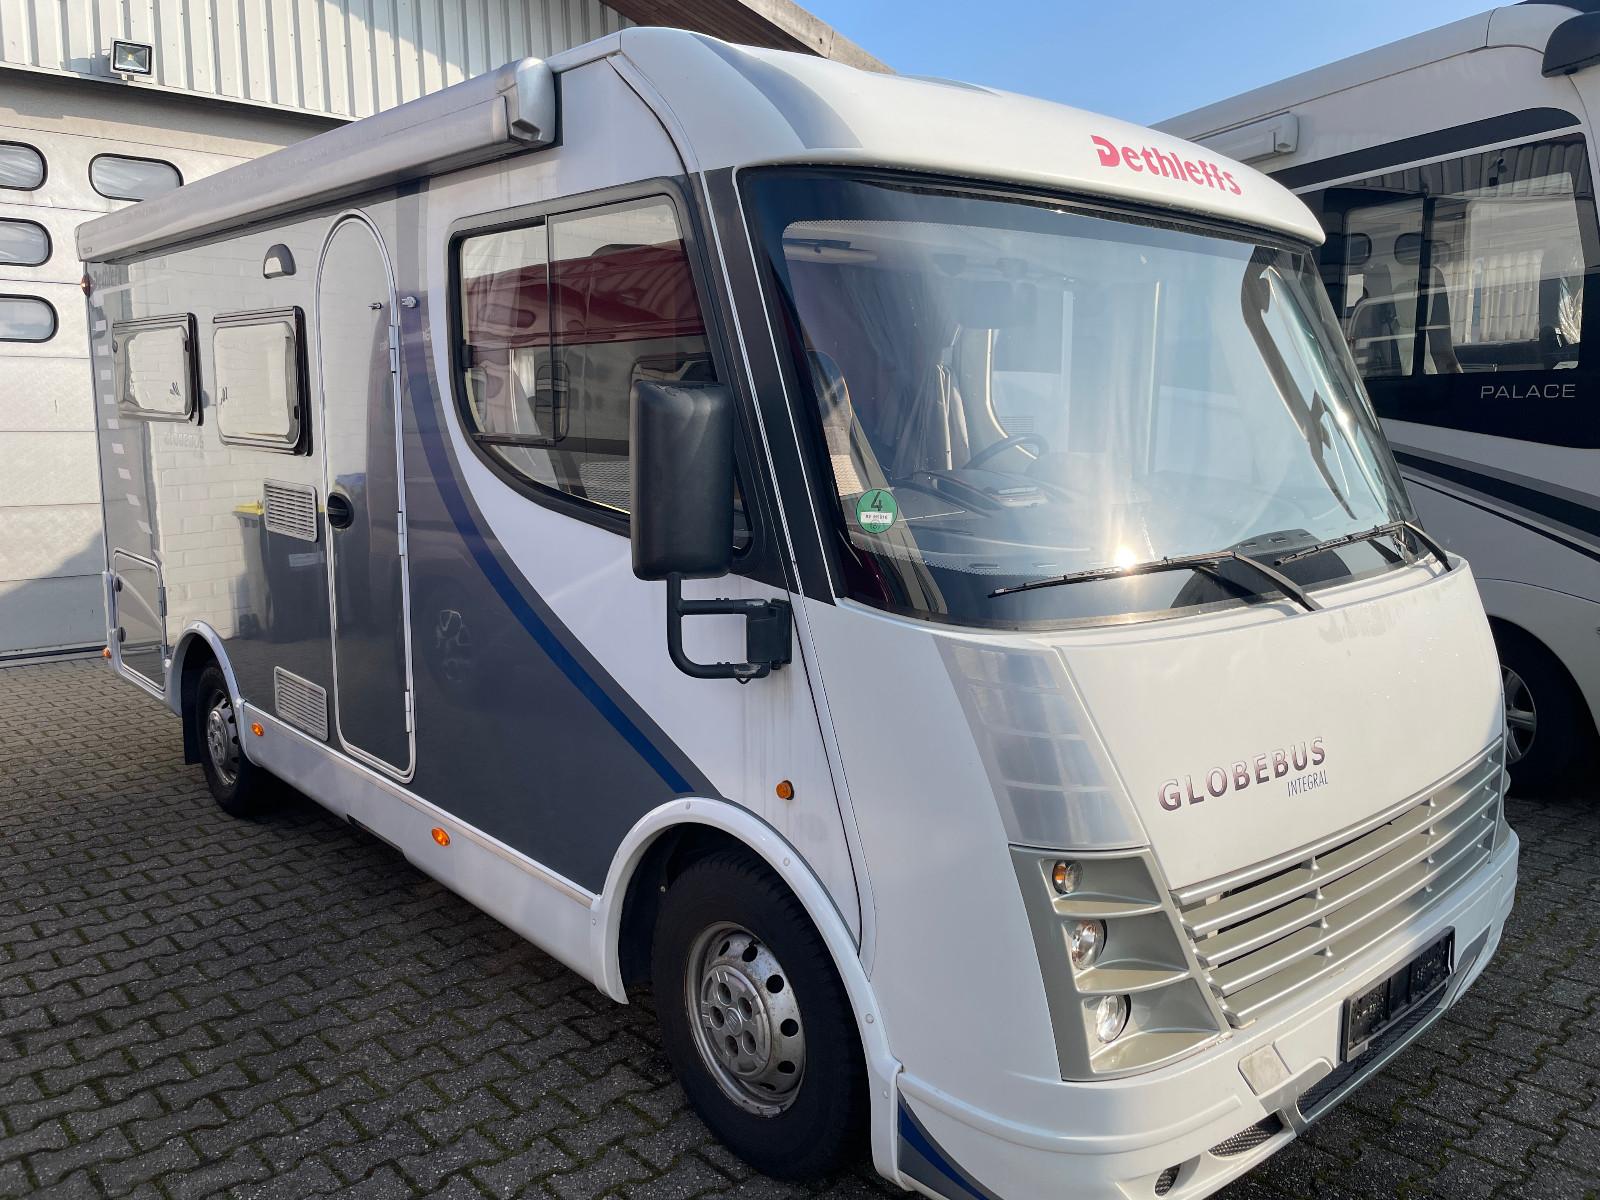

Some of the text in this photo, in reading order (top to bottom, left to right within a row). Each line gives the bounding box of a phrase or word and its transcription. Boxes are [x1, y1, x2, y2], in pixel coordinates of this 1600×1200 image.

[1090, 134, 1242, 196] Dethleffs
[1480, 383, 1576, 399] PALACE
[871, 491, 883, 512] 4
[1158, 736, 1326, 812] GLOBEBUS
[1287, 769, 1329, 798] INTEGRAL
